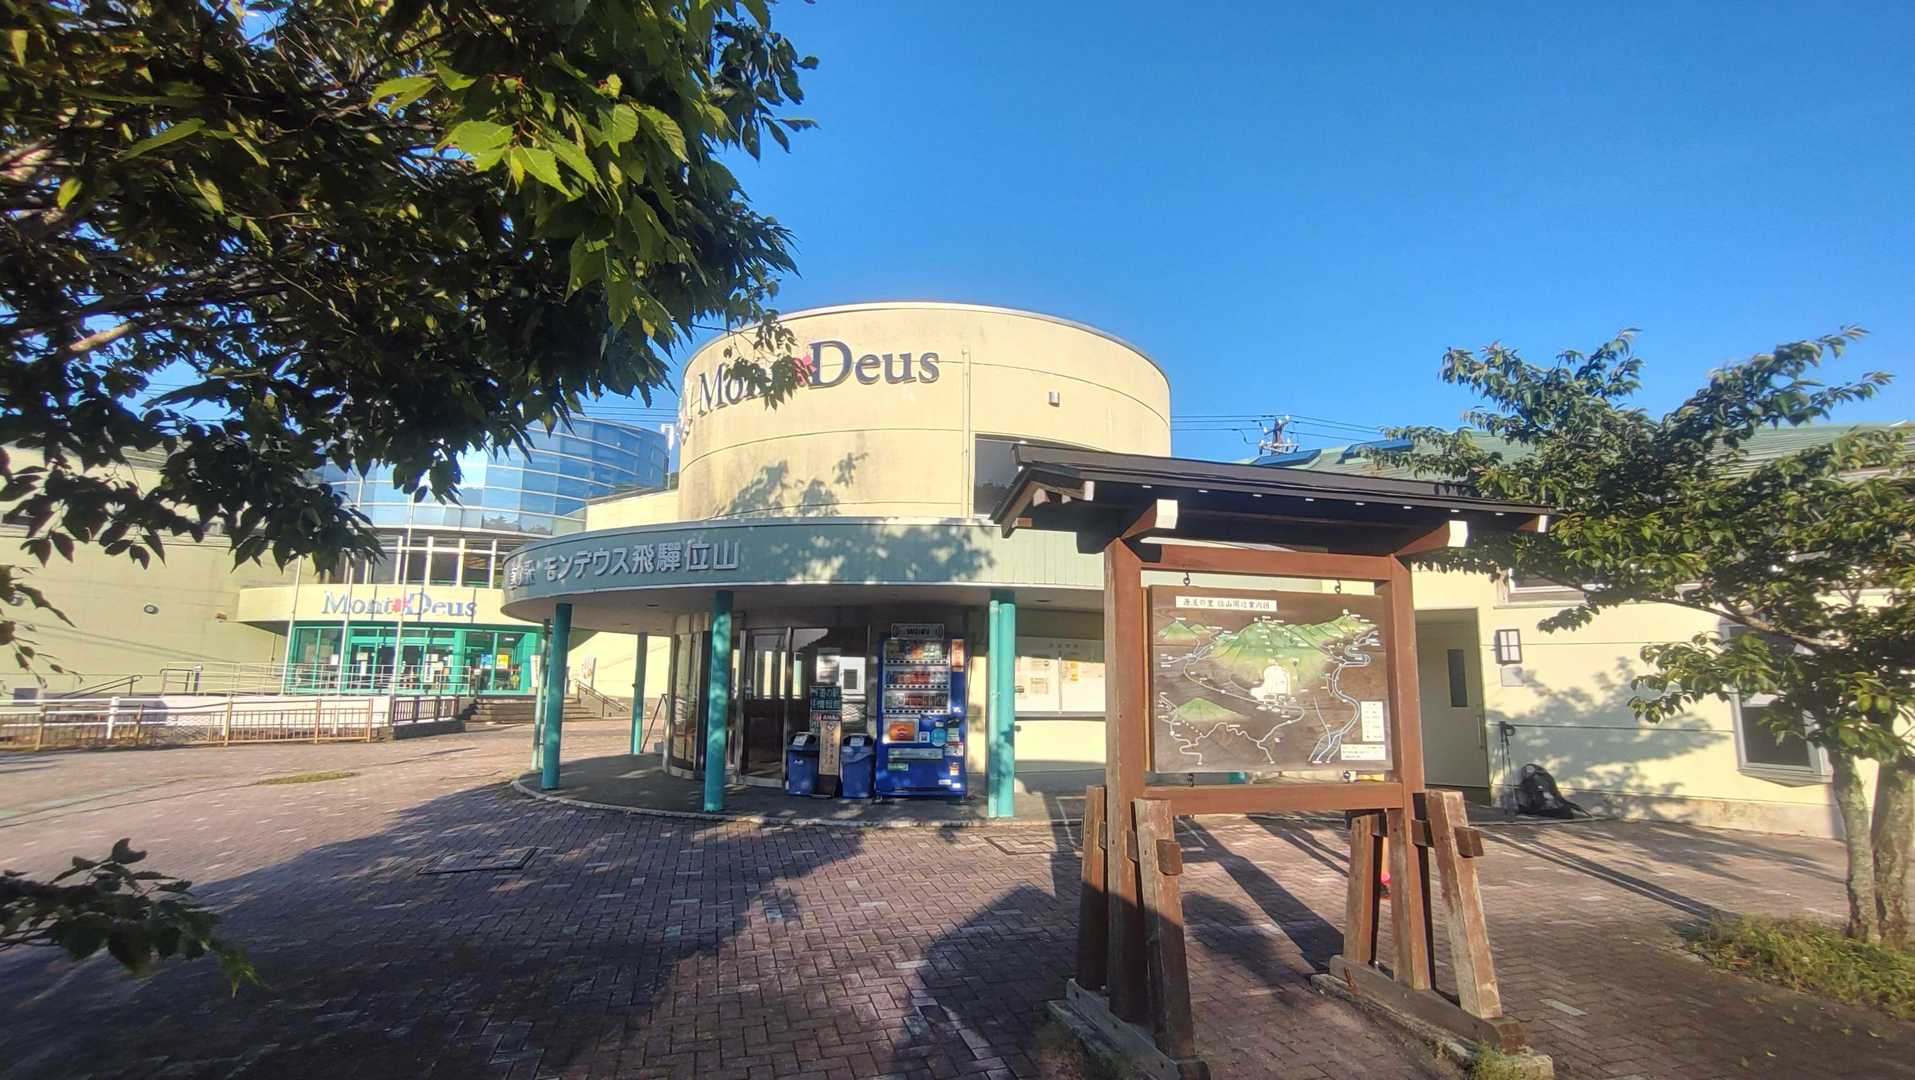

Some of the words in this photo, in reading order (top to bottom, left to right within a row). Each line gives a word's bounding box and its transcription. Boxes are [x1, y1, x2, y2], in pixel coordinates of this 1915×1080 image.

[698, 360, 780, 417] Mo
[809, 339, 940, 390] Deus
[321, 590, 394, 615] Mont
[404, 591, 478, 617] Deus
